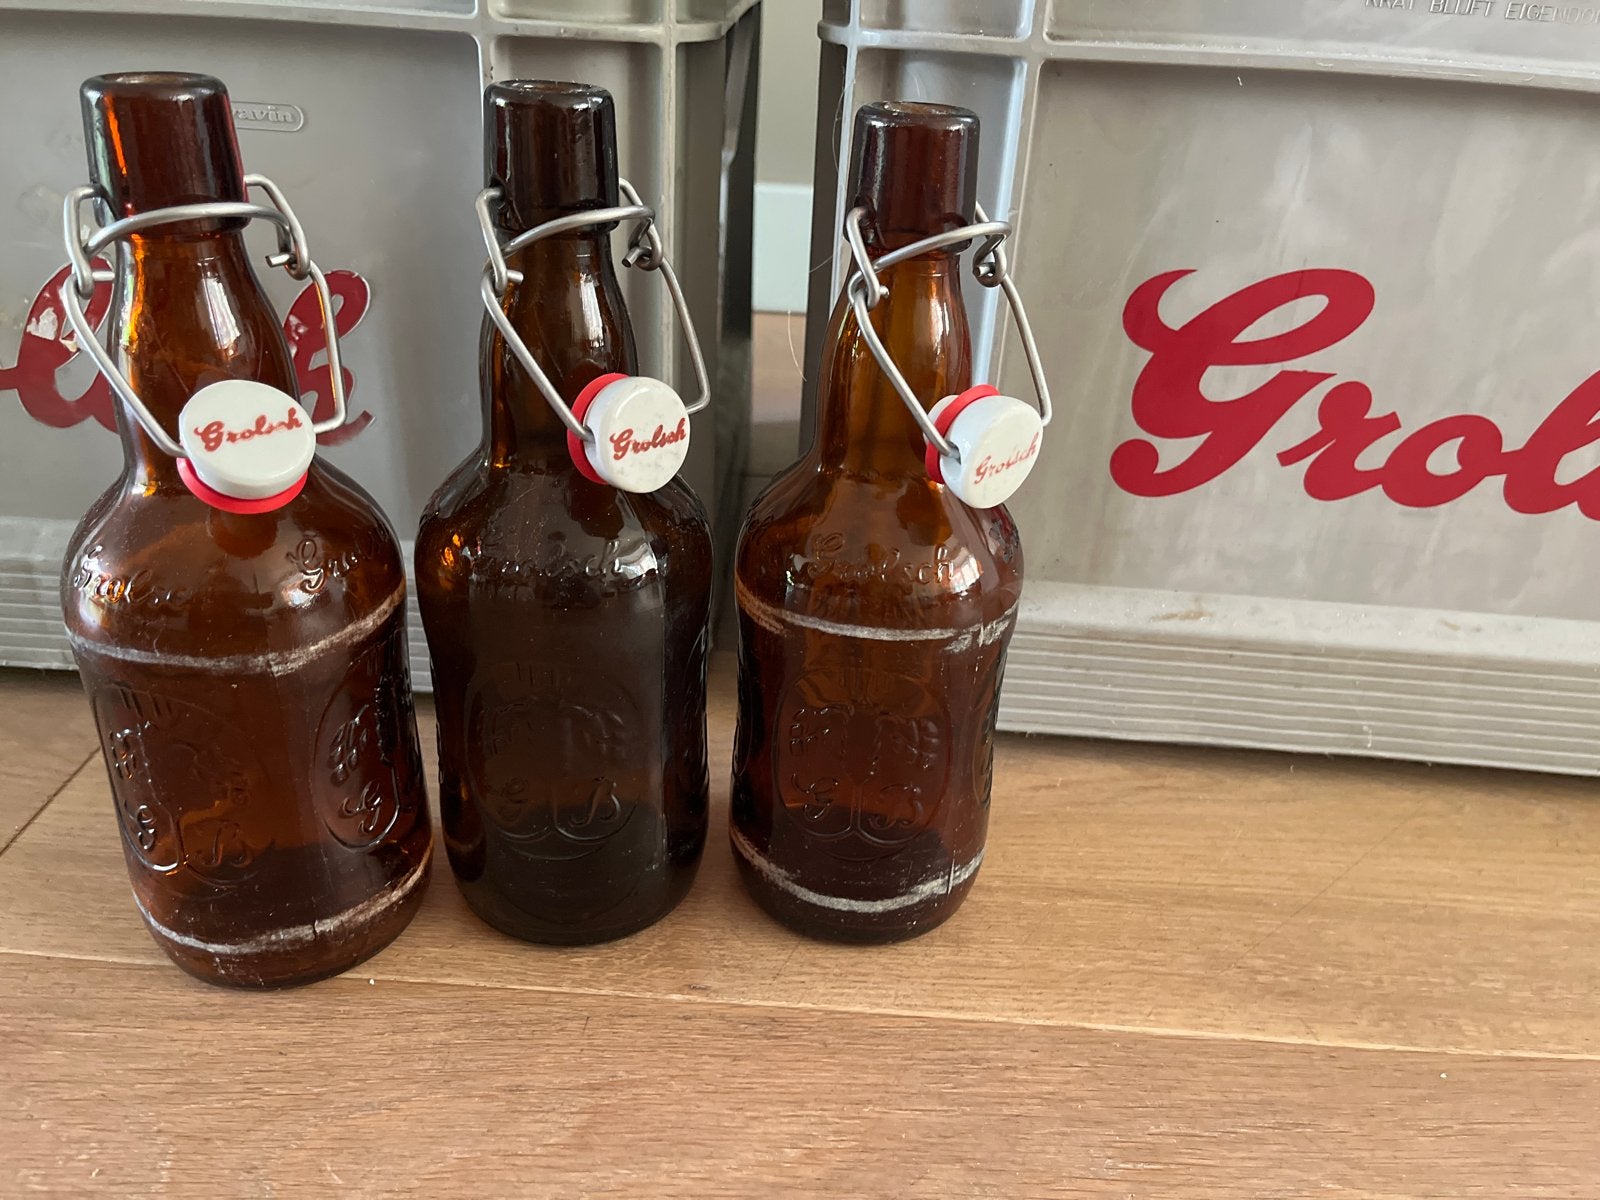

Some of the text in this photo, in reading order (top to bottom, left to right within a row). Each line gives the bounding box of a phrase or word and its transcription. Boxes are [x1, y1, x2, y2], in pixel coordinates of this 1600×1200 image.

[1504, 1, 1600, 23] EIGENDO
[233, 105, 293, 123] avin
[1110, 268, 1600, 521] Grol
[193, 406, 303, 453] Grolsch
[609, 417, 687, 461] Grolsch
[974, 431, 1040, 485] Grolsch
